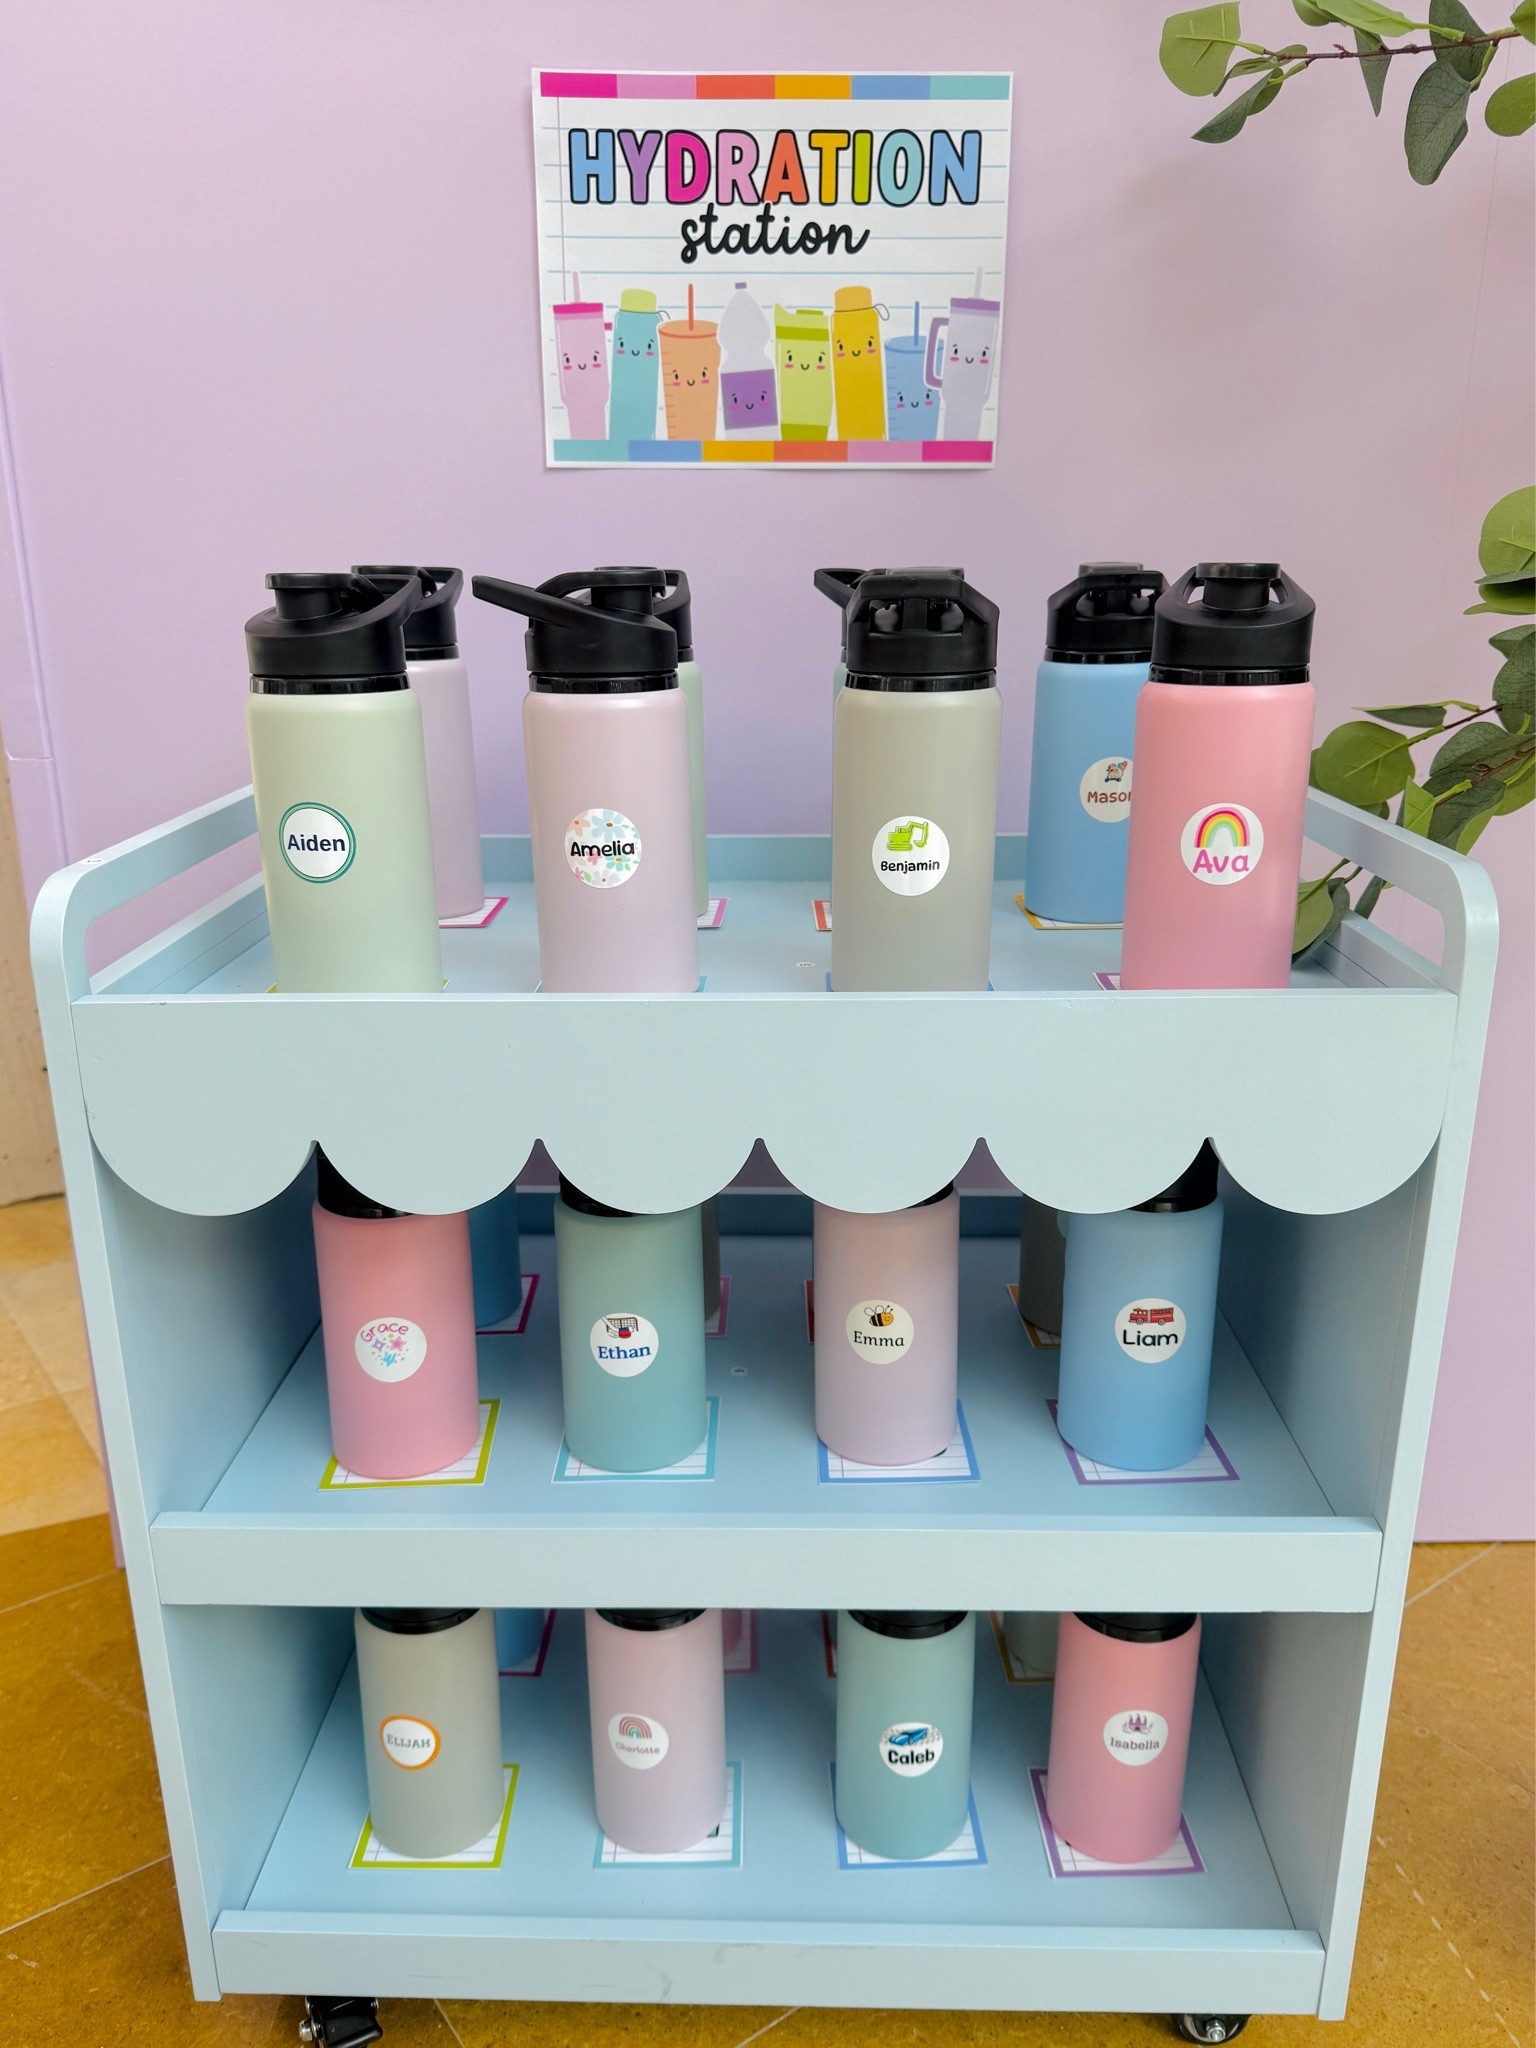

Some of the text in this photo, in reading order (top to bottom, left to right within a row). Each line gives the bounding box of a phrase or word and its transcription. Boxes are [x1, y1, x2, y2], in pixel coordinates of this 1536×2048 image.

[568, 128, 982, 207] HYDRATION
[680, 202, 871, 263] station
[287, 832, 346, 852] Aiden
[570, 840, 635, 857] Amelia
[880, 859, 940, 874] Benjamin
[1192, 850, 1250, 874] Ava
[360, 1323, 409, 1343] Grace
[853, 1330, 905, 1347] Emma
[1123, 1329, 1178, 1347] Liam
[597, 1344, 652, 1360] Ethan
[386, 1733, 431, 1750] ELIJAH
[615, 1741, 661, 1756] Charlotte
[1110, 1736, 1160, 1751] Isabella
[888, 1749, 935, 1766] Caleb
